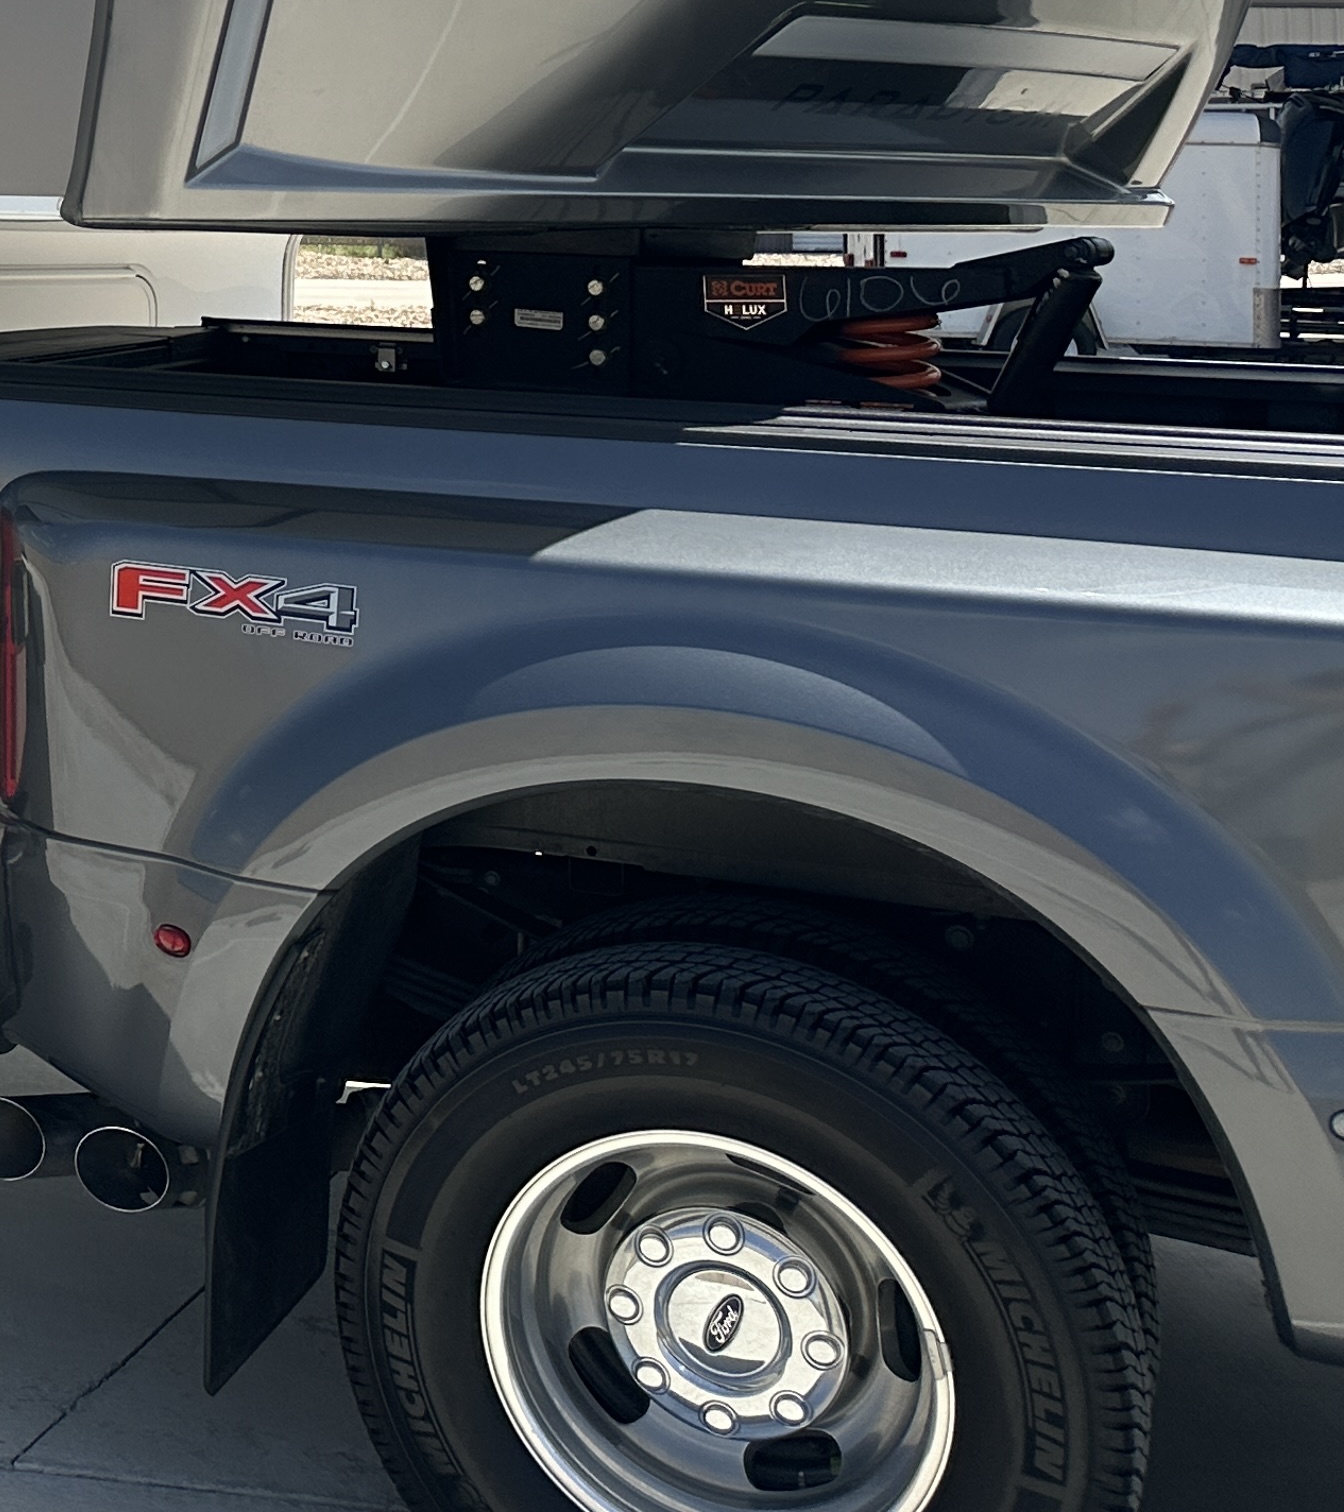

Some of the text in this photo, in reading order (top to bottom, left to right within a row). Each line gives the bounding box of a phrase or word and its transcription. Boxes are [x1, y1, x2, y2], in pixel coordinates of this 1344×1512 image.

[799, 274, 961, 323] 6106
[111, 560, 359, 635] FX4
[240, 622, 354, 648] OFF ROAD
[710, 1304, 740, 1344] Ford
[381, 1249, 460, 1476] MICHELIN
[971, 1240, 1067, 1482] MICHELIN
